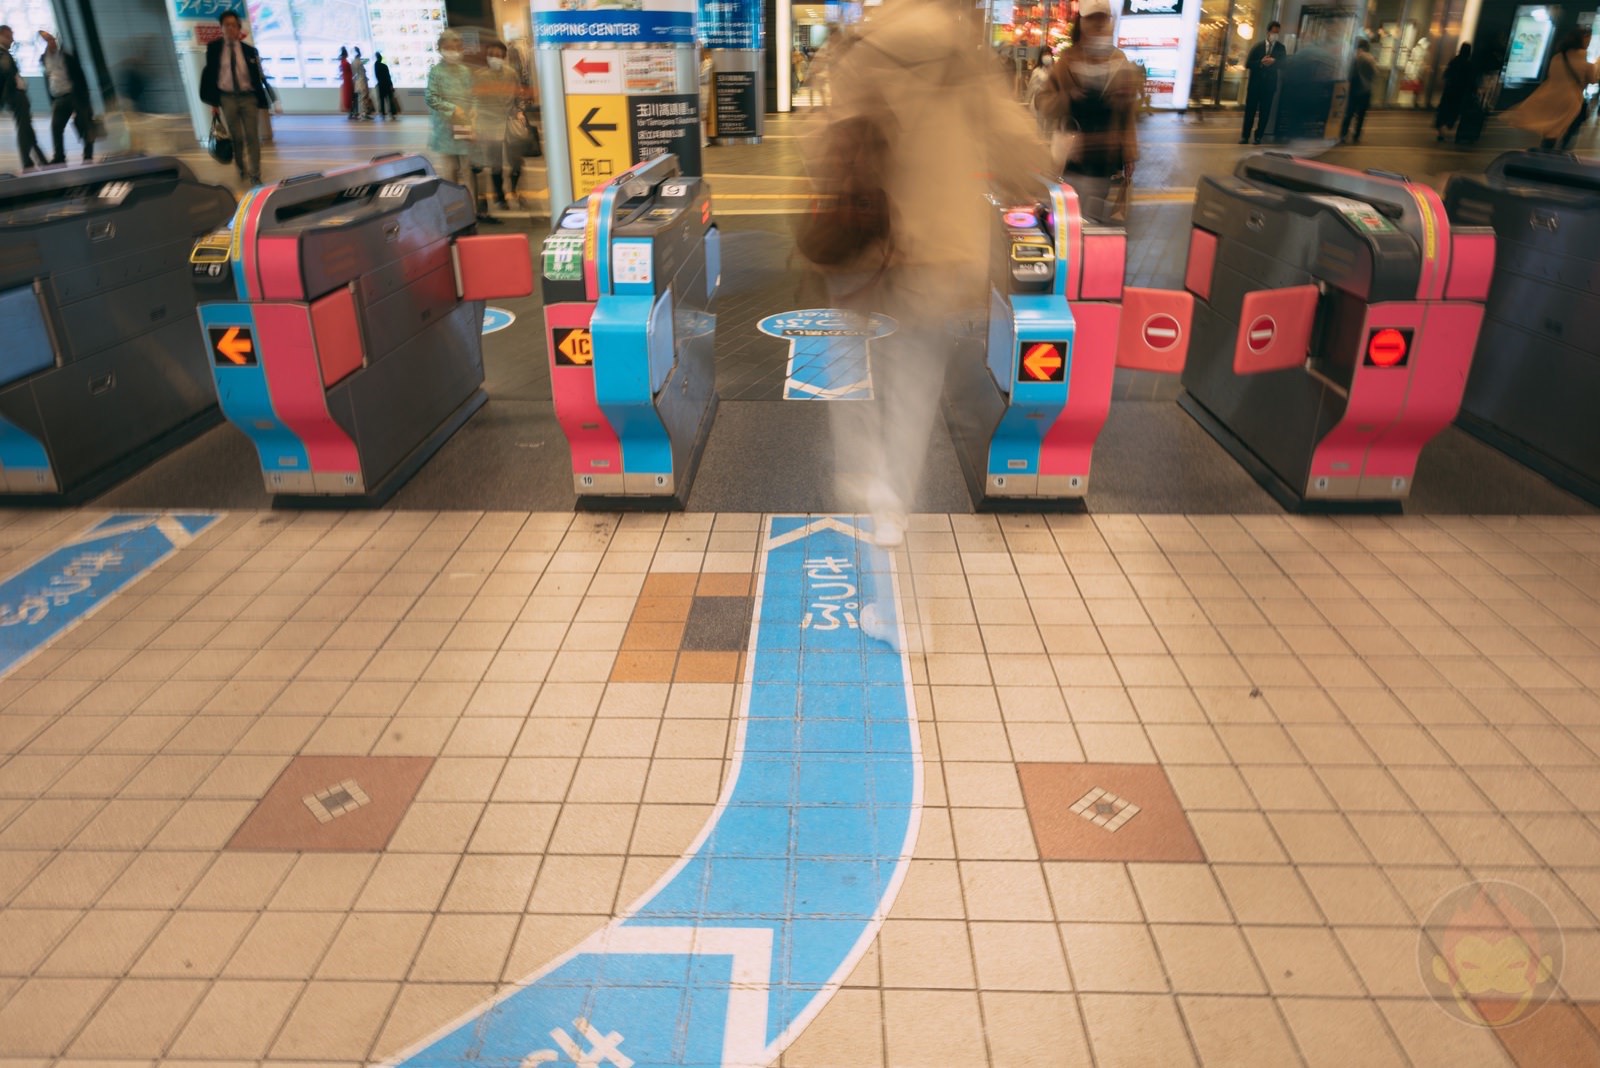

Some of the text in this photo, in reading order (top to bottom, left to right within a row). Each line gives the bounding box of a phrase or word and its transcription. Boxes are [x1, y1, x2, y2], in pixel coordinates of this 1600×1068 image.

[538, 22, 588, 37] SHOPPING
[588, 22, 640, 37] CENTER
[580, 158, 613, 176] 西口
[572, 338, 591, 355] IC
[583, 476, 592, 485] 10
[799, 556, 860, 630] きっぷ
